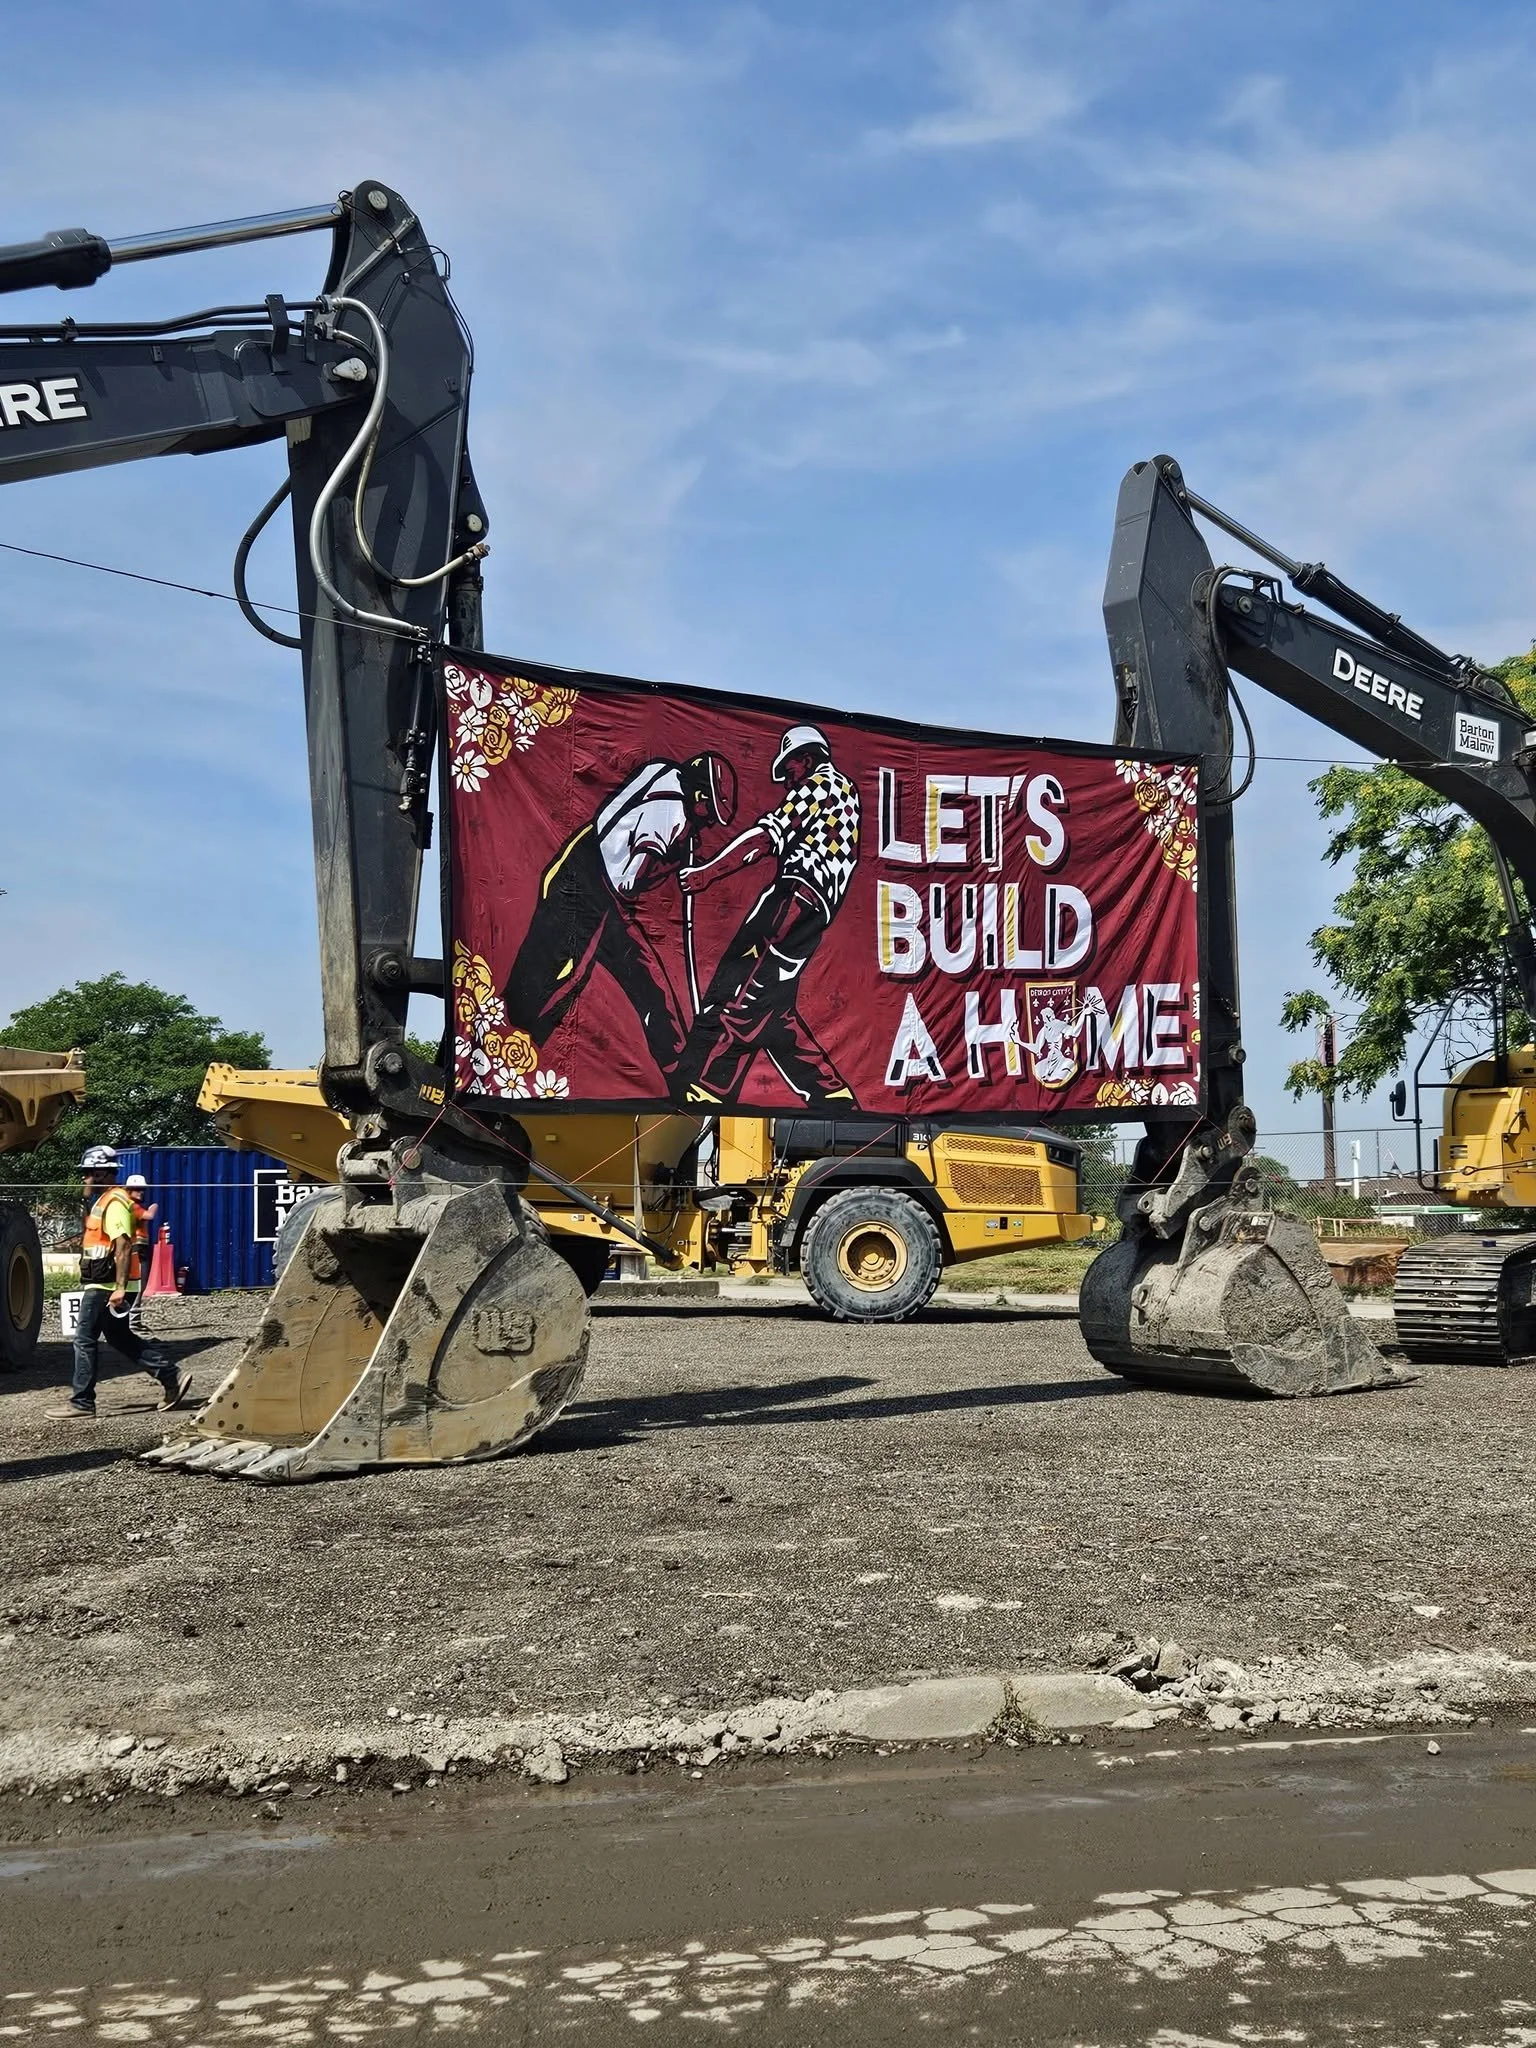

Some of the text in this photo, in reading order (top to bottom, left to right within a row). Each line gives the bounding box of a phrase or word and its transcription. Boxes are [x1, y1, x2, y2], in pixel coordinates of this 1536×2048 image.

[0, 378, 87, 427] RE
[1332, 648, 1424, 721] DEERE
[1459, 719, 1494, 740] Barton
[1459, 733, 1494, 754] Malow
[878, 767, 1066, 871] LET'S
[877, 879, 1093, 974] BUILD
[884, 982, 1186, 1087] A HME
